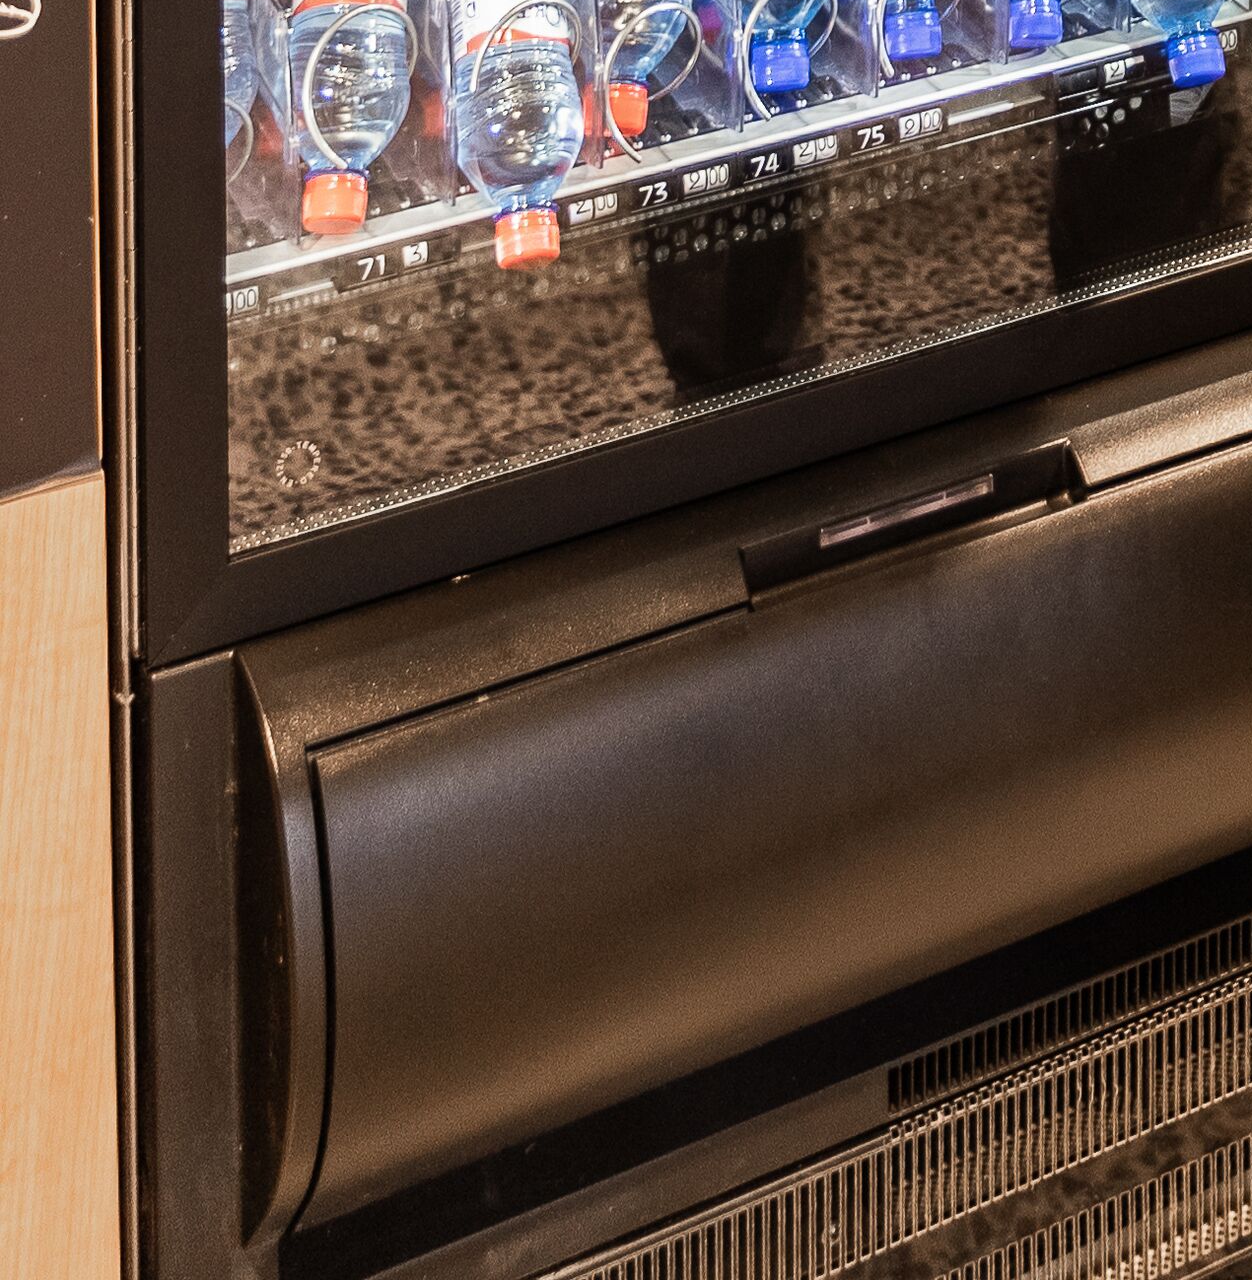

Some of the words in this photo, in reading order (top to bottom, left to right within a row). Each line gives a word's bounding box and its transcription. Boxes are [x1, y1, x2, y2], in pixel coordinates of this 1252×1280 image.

[857, 124, 885, 148] 75
[750, 153, 780, 177] 74
[638, 183, 669, 208] 73
[356, 255, 386, 282] 71
